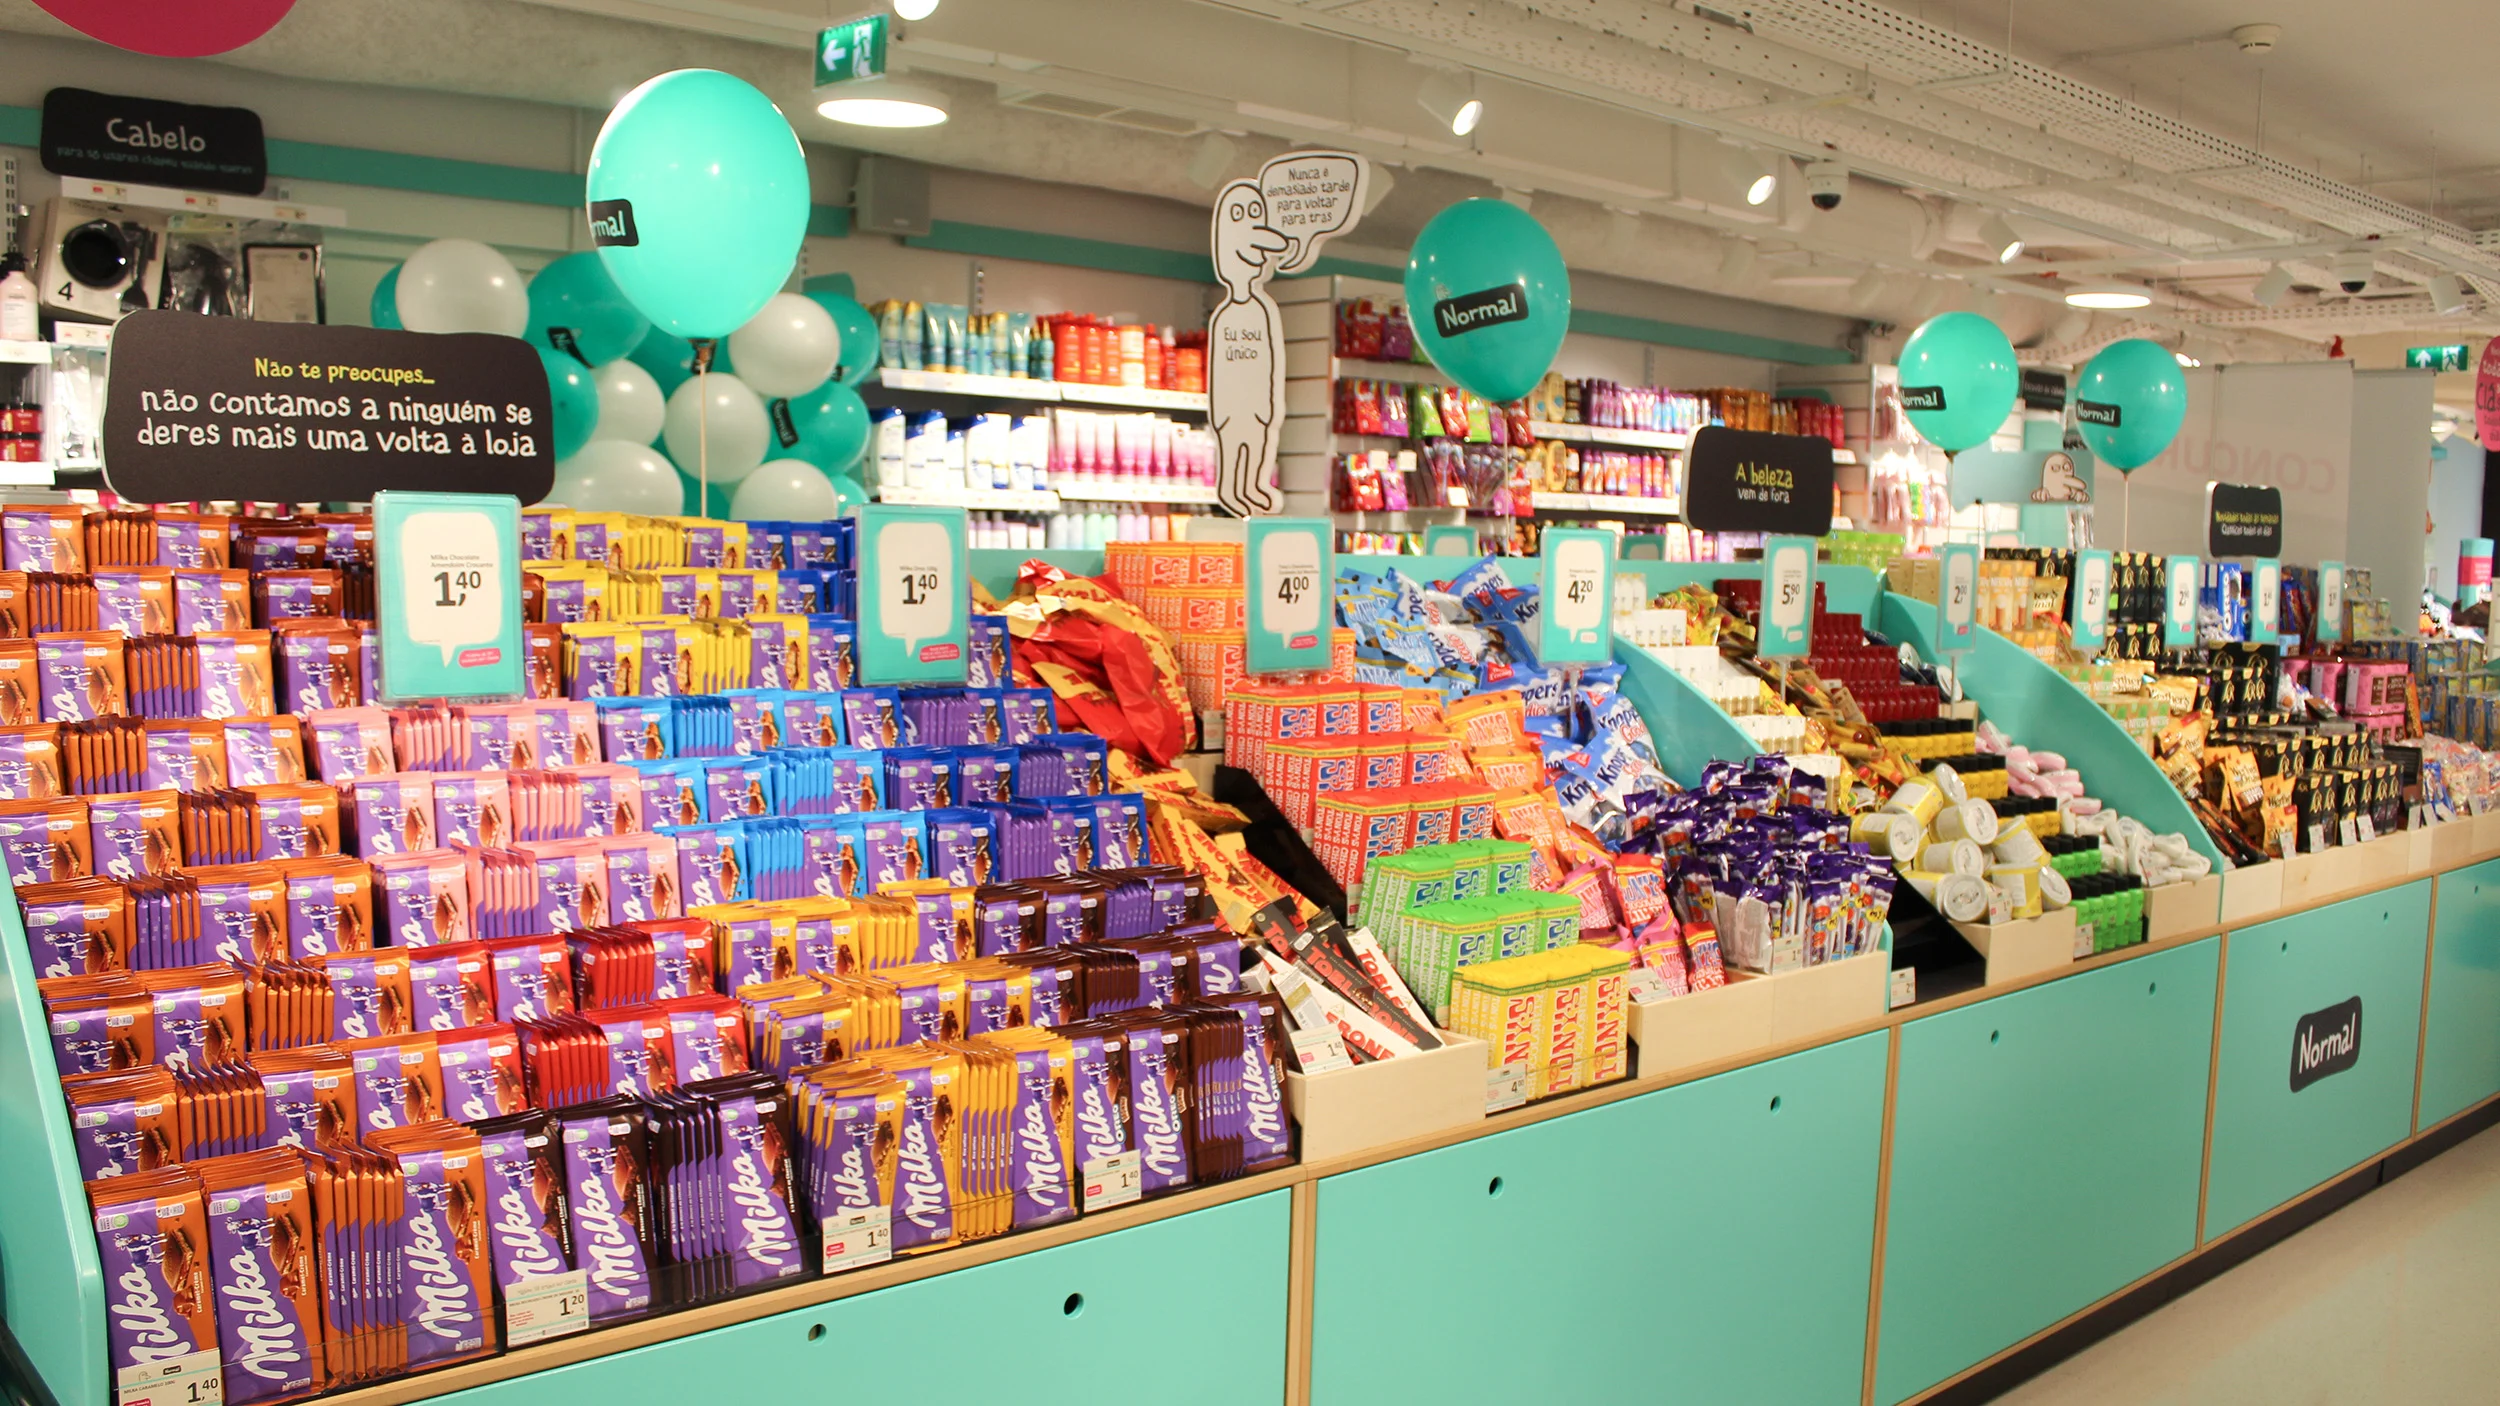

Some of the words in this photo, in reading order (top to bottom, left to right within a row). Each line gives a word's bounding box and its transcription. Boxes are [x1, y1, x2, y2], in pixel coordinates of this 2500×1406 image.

[106, 118, 206, 152] Cabelo
[1266, 181, 1317, 198] demasiado
[1321, 179, 1350, 193] tarde
[1288, 167, 1320, 181] Nunca
[1277, 201, 1302, 213] para
[1304, 196, 1339, 209] voltar
[1281, 215, 1306, 227] para
[58, 281, 74, 301] 4
[1441, 291, 1518, 330] Normal
[1224, 326, 1237, 341] Eu
[1241, 328, 1262, 341] sou
[254, 357, 293, 378] Não
[300, 361, 321, 379] te
[1225, 345, 1258, 362] único
[141, 389, 199, 414] não
[209, 390, 351, 418] contamos
[361, 397, 380, 421] a
[388, 396, 496, 426] ninguém
[505, 402, 533, 425] se
[2077, 402, 2115, 422] Normal
[136, 417, 221, 447] deres
[231, 421, 297, 449] mais
[307, 428, 369, 452] uma
[377, 425, 451, 455] volta
[460, 433, 477, 455] à
[486, 428, 537, 458] loja
[1735, 462, 1747, 482] A
[1750, 461, 1794, 489] beleza
[1737, 487, 1756, 500] vem
[1758, 487, 1768, 502] de
[1770, 488, 1790, 504] fora
[433, 570, 482, 607] 1,40
[902, 573, 938, 605] 1,40
[1278, 575, 1310, 604] 4,00
[1568, 580, 1594, 604] 4,20
[1781, 583, 1801, 605] 5,90
[1503, 995, 1536, 1066] NY'S
[1242, 1044, 1282, 1144] Milka
[1111, 1103, 1126, 1145] OREO
[1135, 1073, 1181, 1176] Milka
[1169, 1094, 1183, 1133] OREO
[1018, 1099, 1064, 1206] Milka
[832, 1144, 878, 1217] ilka
[898, 1118, 947, 1229] Milka
[727, 1149, 793, 1266] Milka
[574, 1171, 641, 1297] Milka
[404, 1208, 475, 1339] Milka
[221, 1246, 301, 1380] Milka
[123, 1387, 138, 1395] MILKA
[139, 1382, 164, 1392] CARAMELO
